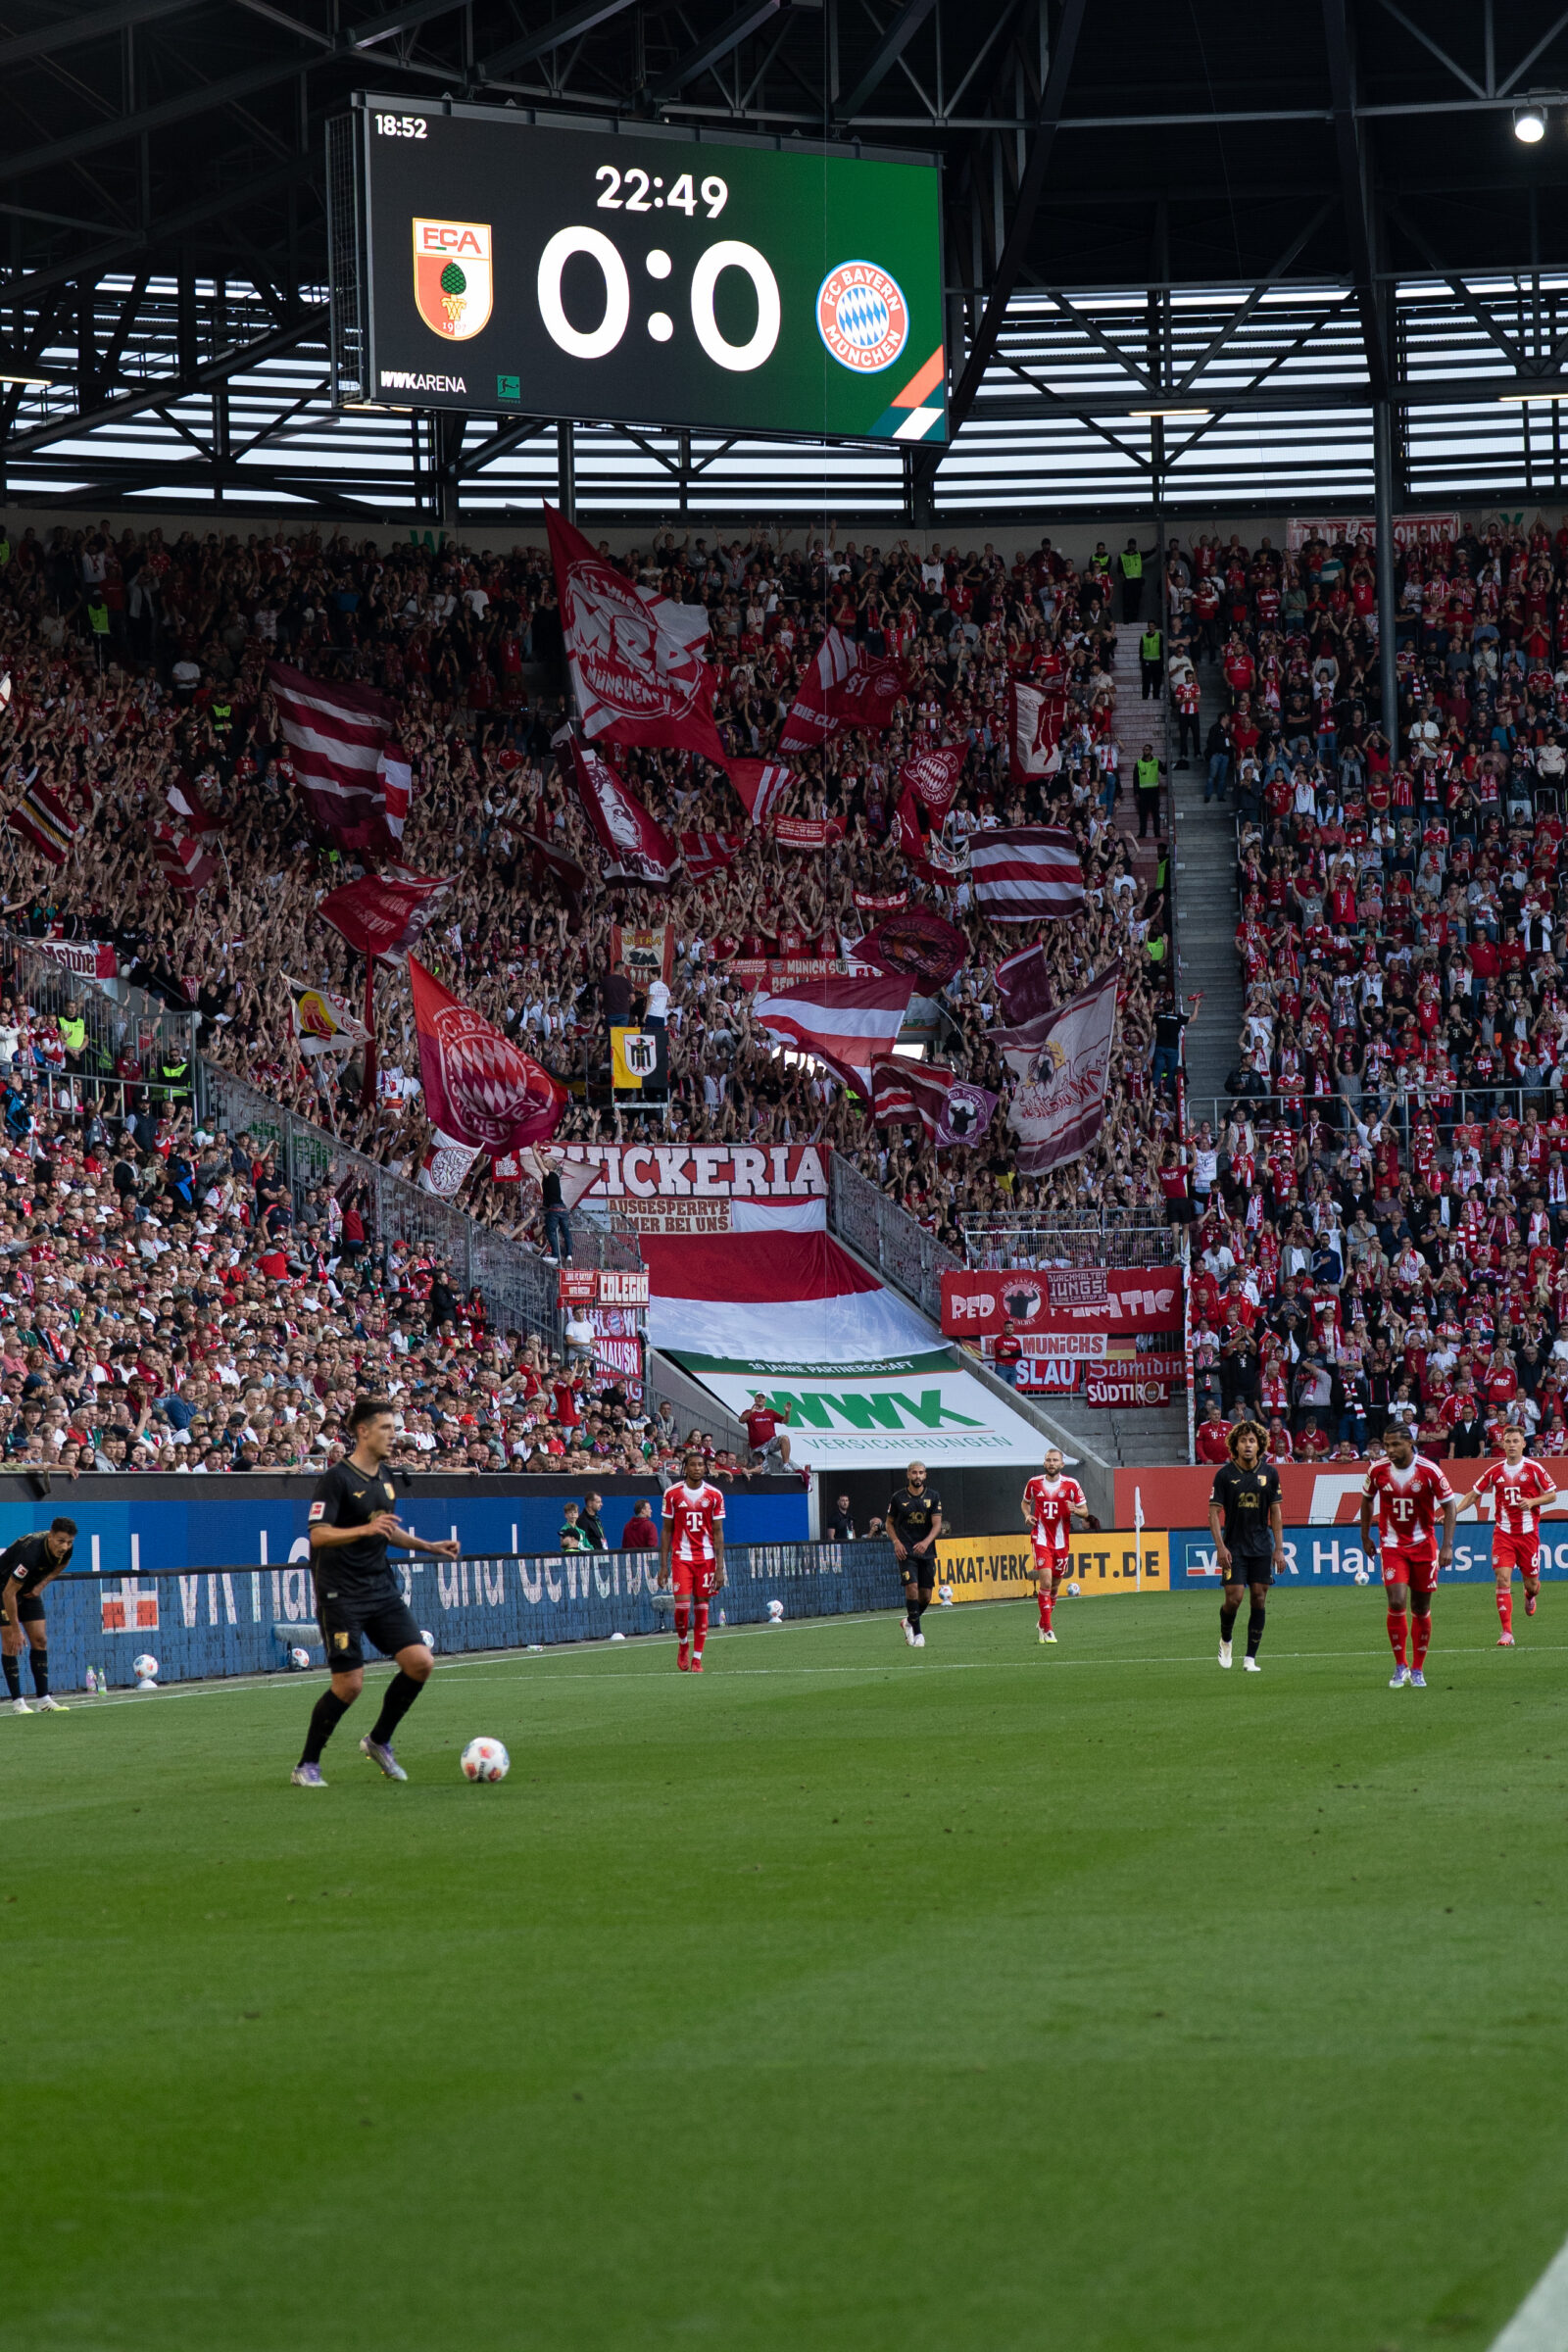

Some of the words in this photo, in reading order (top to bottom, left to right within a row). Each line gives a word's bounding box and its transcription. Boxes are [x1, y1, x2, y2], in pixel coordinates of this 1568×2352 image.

[374, 114, 428, 139] 18:52
[595, 165, 729, 219] 22:49
[423, 226, 482, 254] FCA
[823, 280, 842, 307] FC
[841, 268, 902, 312] BAYERN
[824, 324, 902, 367] MÜNCHEN
[609, 1199, 730, 1216] AUSGESPERRTE
[664, 1216, 692, 1233] BEI
[697, 1215, 729, 1232] UNS
[1050, 1279, 1107, 1297] JUNGS!
[951, 1294, 995, 1319] RED
[765, 1362, 807, 1374] JAHRE
[808, 1359, 915, 1374] PARTNERSCHAFT
[1015, 1360, 1077, 1386] SLAU
[746, 1389, 987, 1430] WWK
[802, 1435, 1014, 1450] VERSICHERUNGEN
[686, 1511, 704, 1532] T
[1043, 1501, 1058, 1520] T
[1393, 1497, 1414, 1522] T
